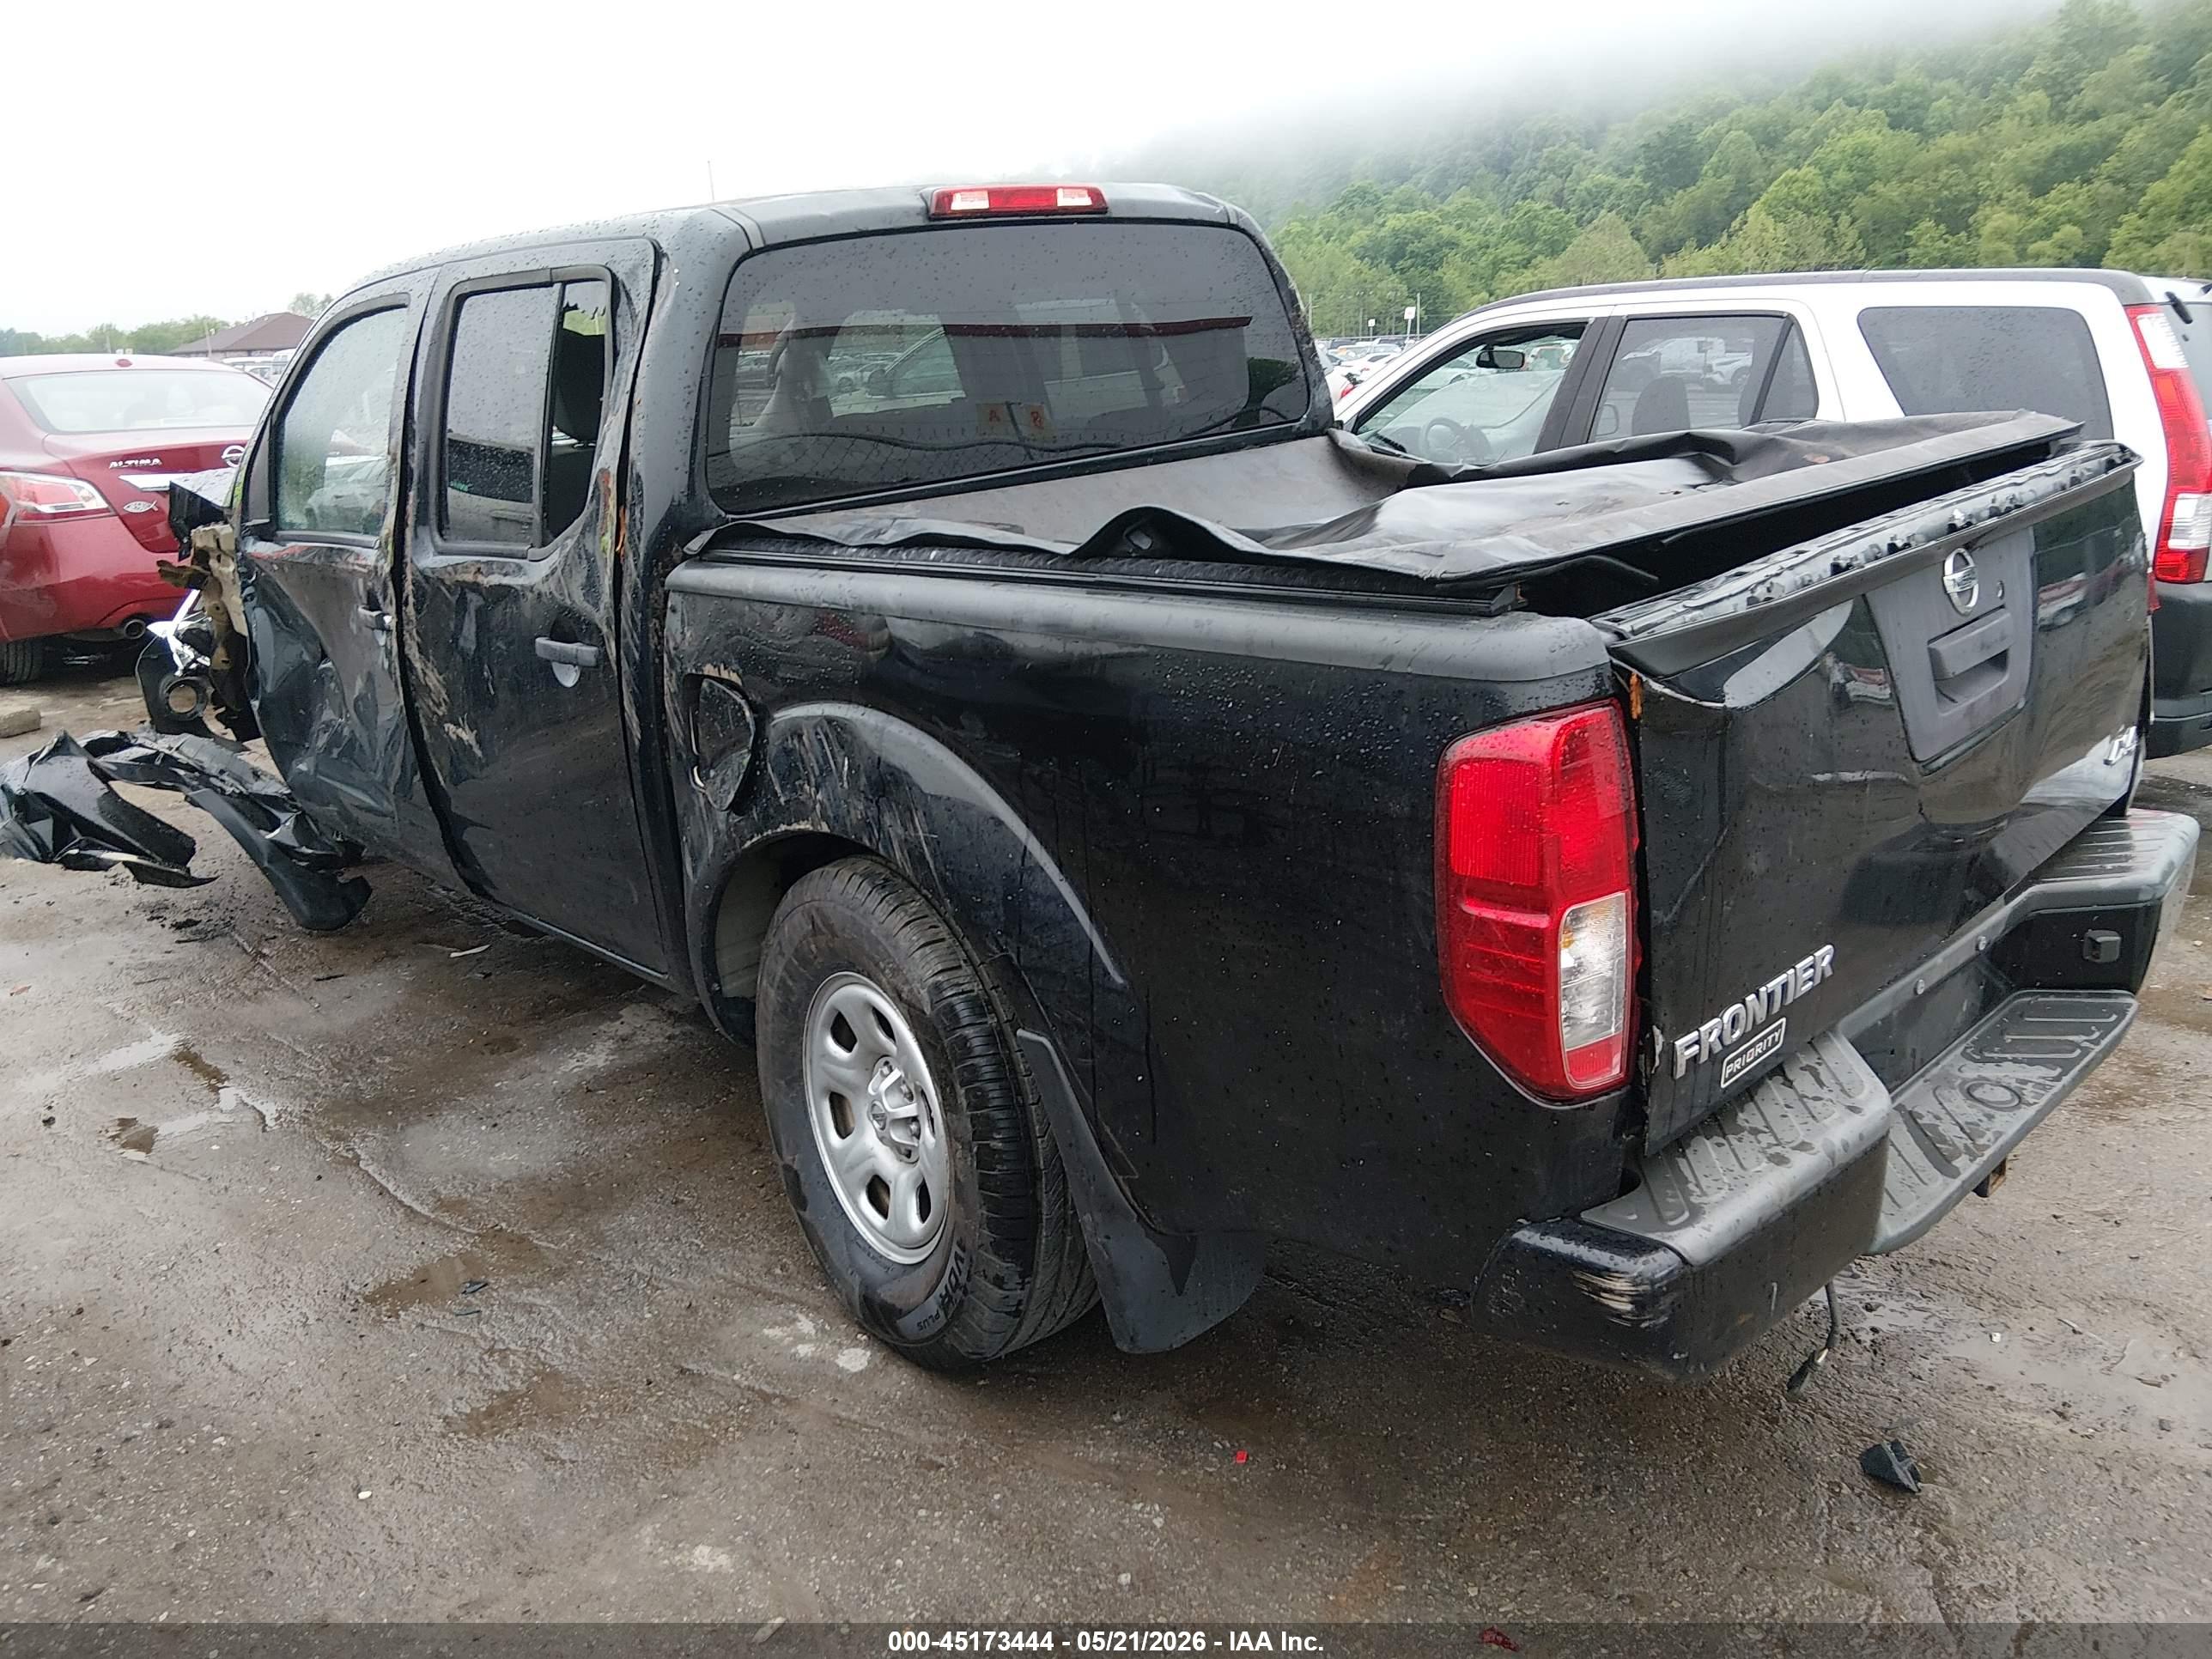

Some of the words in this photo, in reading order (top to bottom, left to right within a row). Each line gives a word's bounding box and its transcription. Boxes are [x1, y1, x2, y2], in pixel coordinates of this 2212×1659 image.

[109, 458, 162, 470] ALTIMA
[1674, 944, 1835, 1080] FRONTIER
[1725, 1029, 1783, 1079] PRIORITY
[916, 1309, 941, 1332] PLUS
